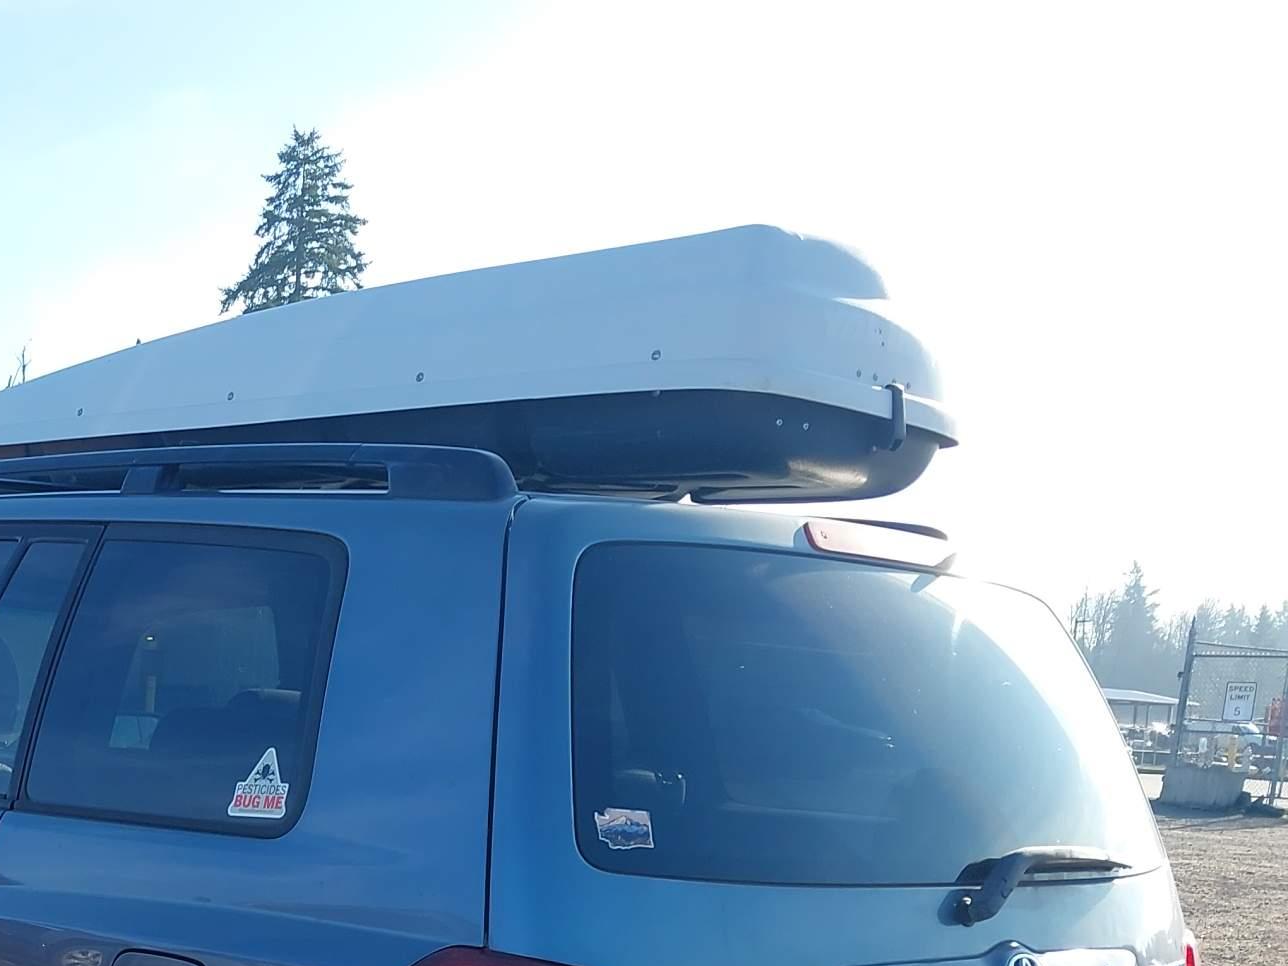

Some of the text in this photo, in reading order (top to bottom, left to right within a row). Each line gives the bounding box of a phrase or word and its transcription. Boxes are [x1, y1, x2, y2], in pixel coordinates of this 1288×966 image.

[236, 783, 287, 795] PESTICIDES
[233, 794, 284, 809] BUG ME
